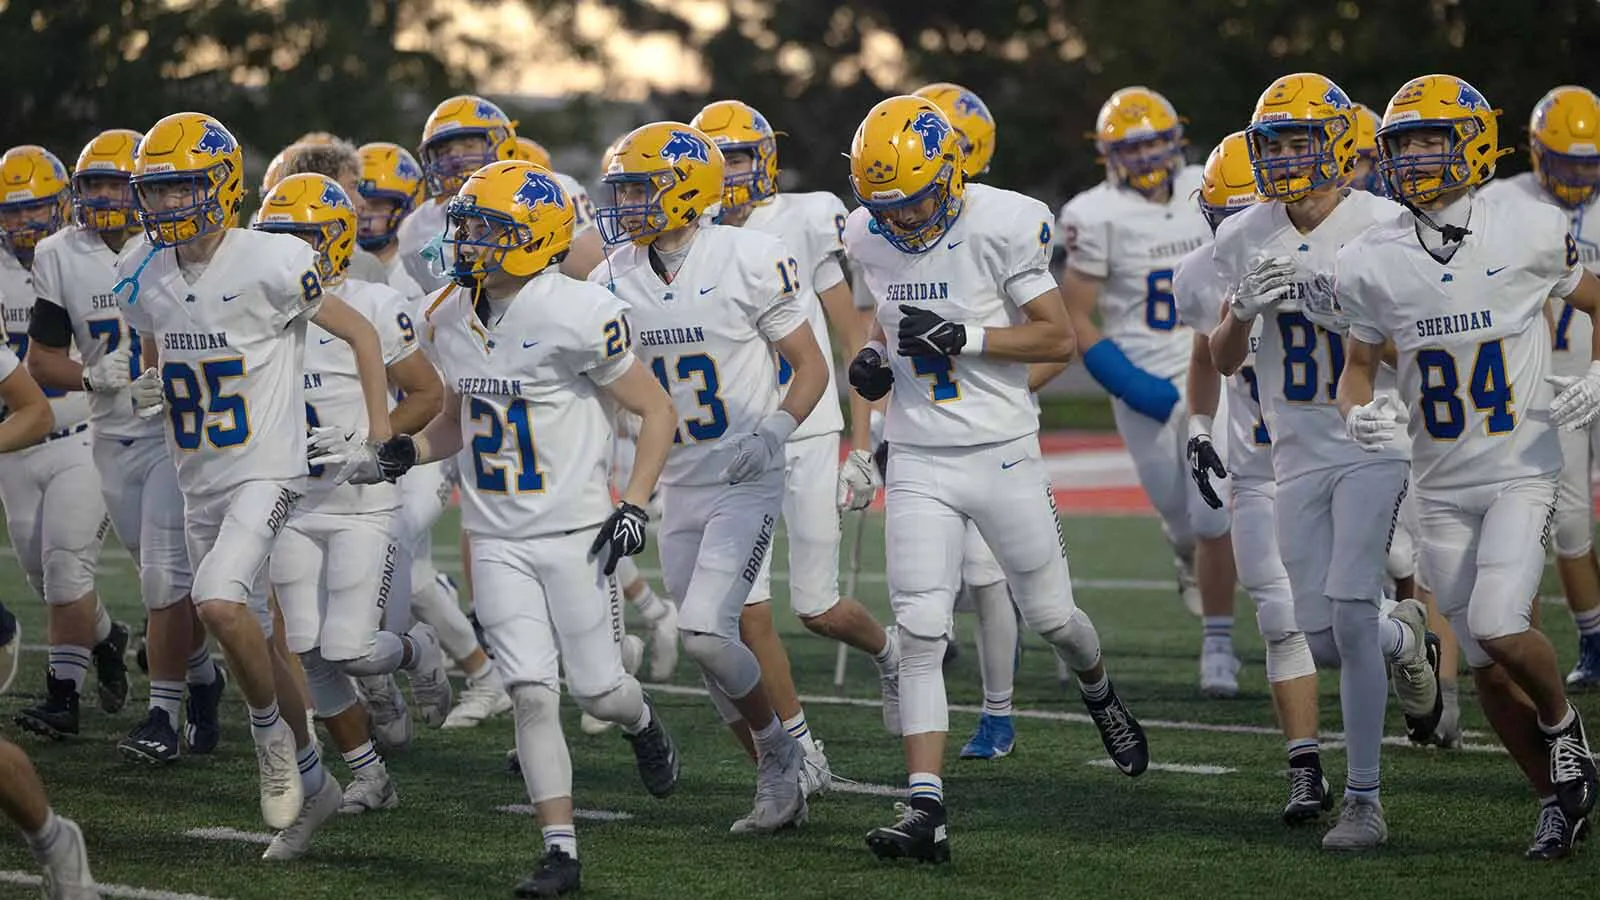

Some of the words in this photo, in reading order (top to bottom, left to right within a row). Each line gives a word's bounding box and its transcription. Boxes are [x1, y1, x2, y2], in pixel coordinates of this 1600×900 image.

[886, 282, 949, 301] SHERIDAN
[1145, 268, 1178, 331] 6
[397, 310, 416, 342] 9
[640, 327, 704, 346] SHERIDAN
[1416, 311, 1493, 337] SHERIDAN
[164, 332, 228, 350] SHERIDAN
[457, 377, 522, 397] SHERIDAN
[1414, 338, 1519, 442] 84
[162, 356, 252, 451] 85
[469, 396, 546, 495] 21
[742, 513, 775, 584] BRONCS
